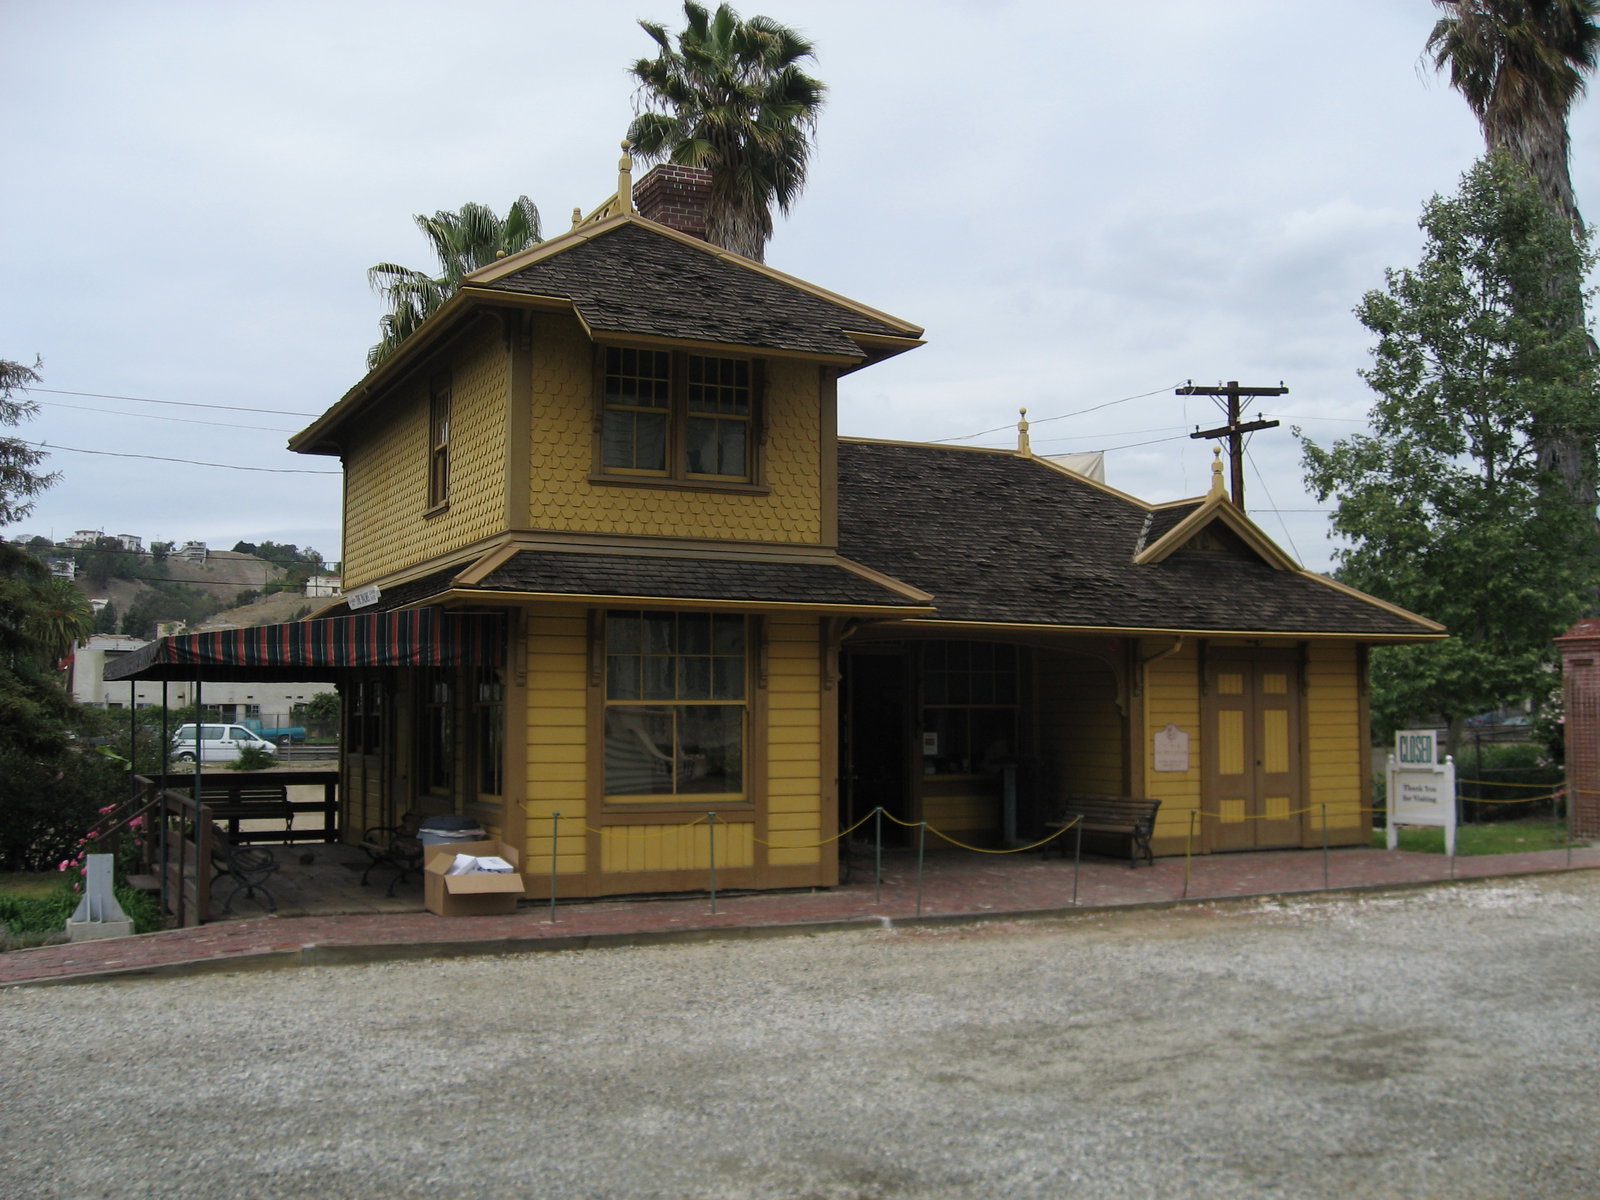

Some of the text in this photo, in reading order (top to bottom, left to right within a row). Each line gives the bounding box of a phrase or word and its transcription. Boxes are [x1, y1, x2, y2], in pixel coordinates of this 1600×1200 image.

[1400, 736, 1432, 763] CLOSED
[1403, 784, 1437, 793] Thank You
[1413, 795, 1437, 804] Visiting
